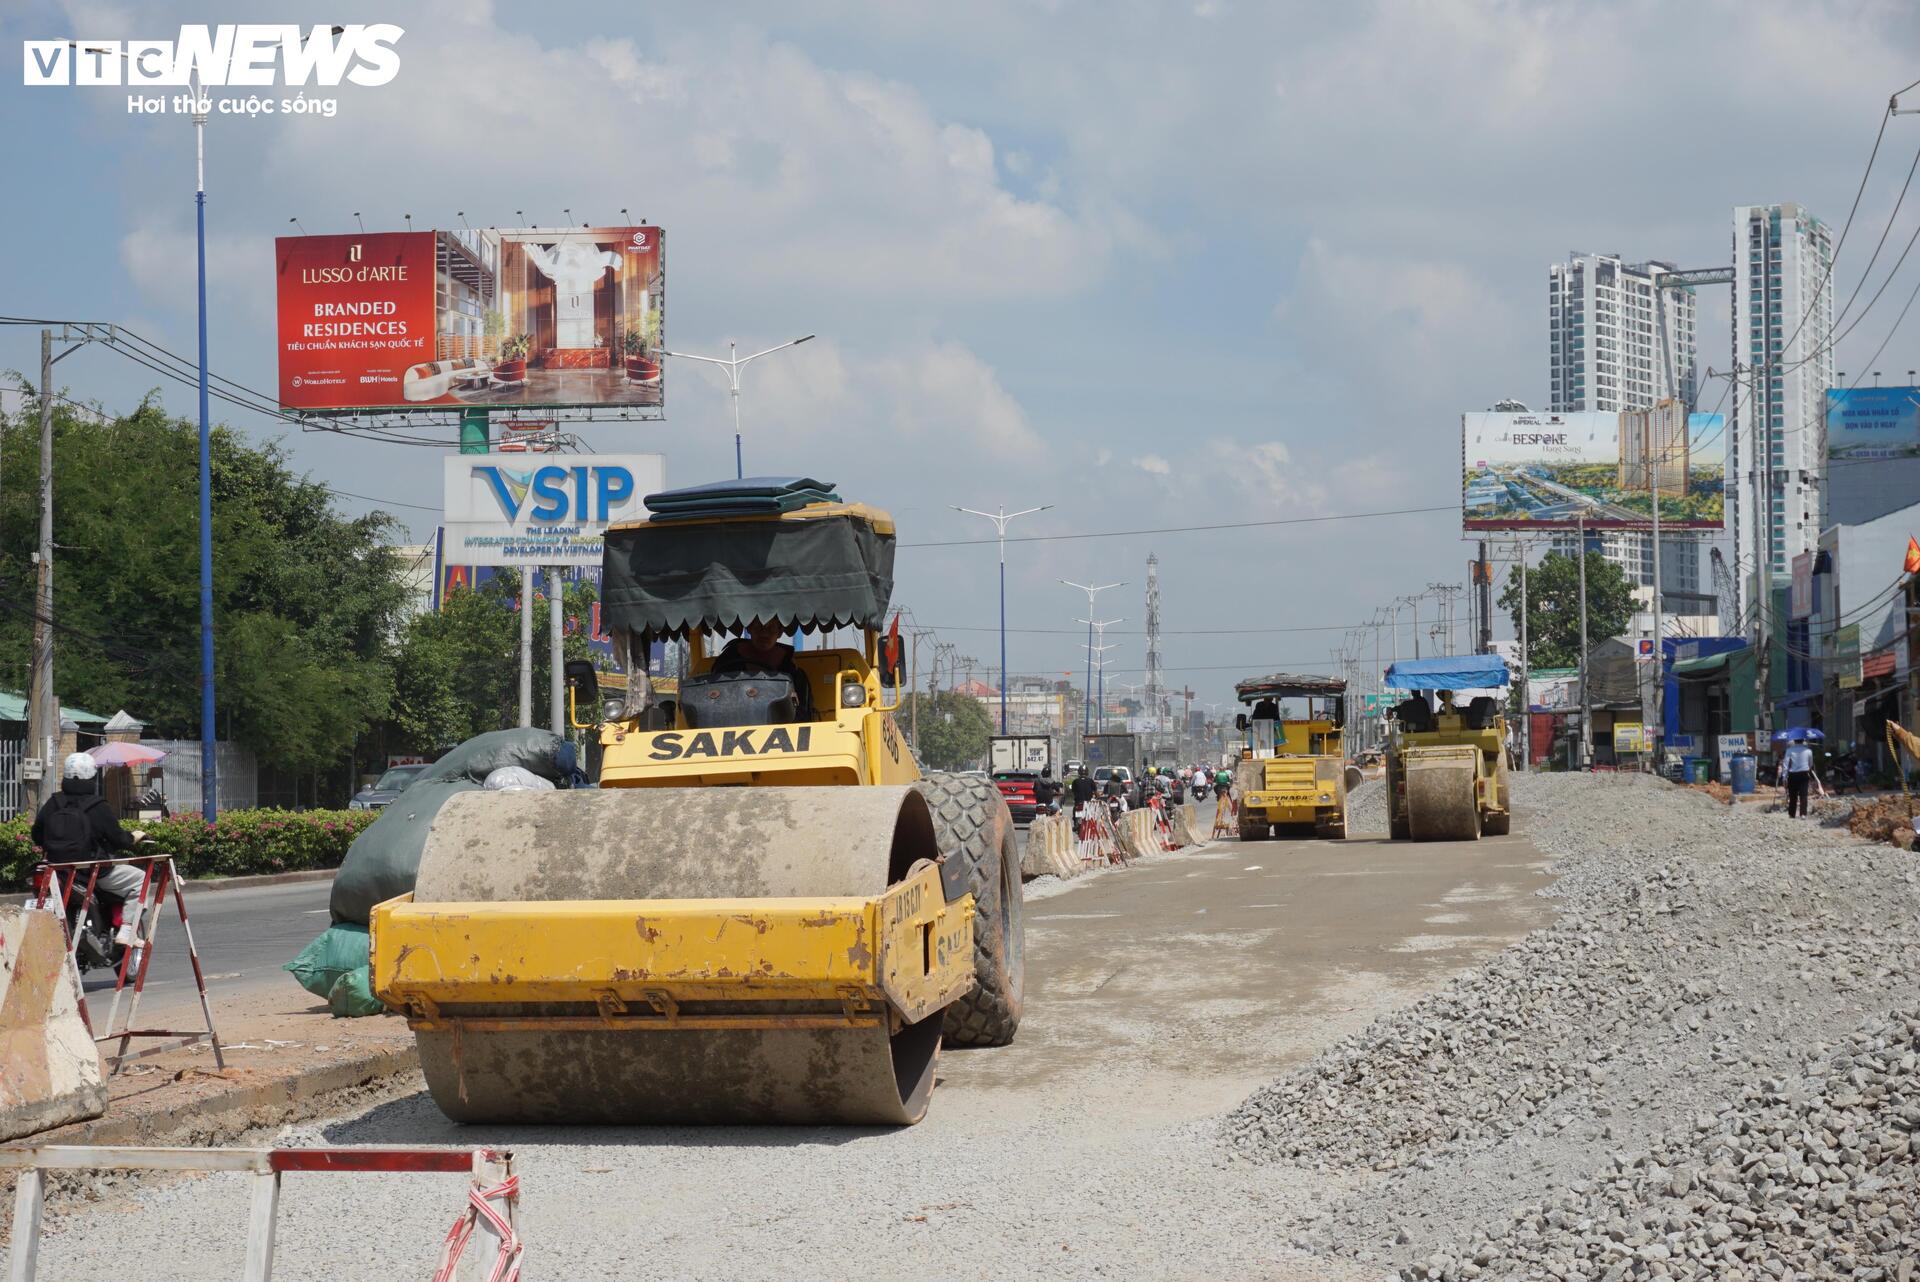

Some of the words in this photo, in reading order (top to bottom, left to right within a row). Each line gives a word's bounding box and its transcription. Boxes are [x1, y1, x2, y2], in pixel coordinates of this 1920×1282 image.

[303, 268, 353, 284] LUSSO
[314, 301, 396, 317] BRANDED
[304, 321, 407, 337] RESIDENCES
[287, 340, 305, 350] TIÊU
[338, 338, 368, 349] KHÁCH
[370, 340, 387, 350] SẠN
[389, 336, 411, 348] QUỐC
[415, 336, 425, 347] TẾ
[1513, 433, 1567, 445] BESPOKE
[472, 466, 634, 523] VSIP
[526, 527, 542, 535] THE
[503, 546, 552, 555] DEVELOPER
[554, 546, 562, 554] IN
[564, 545, 602, 554] VIETNAM
[648, 726, 811, 760] SAKAI
